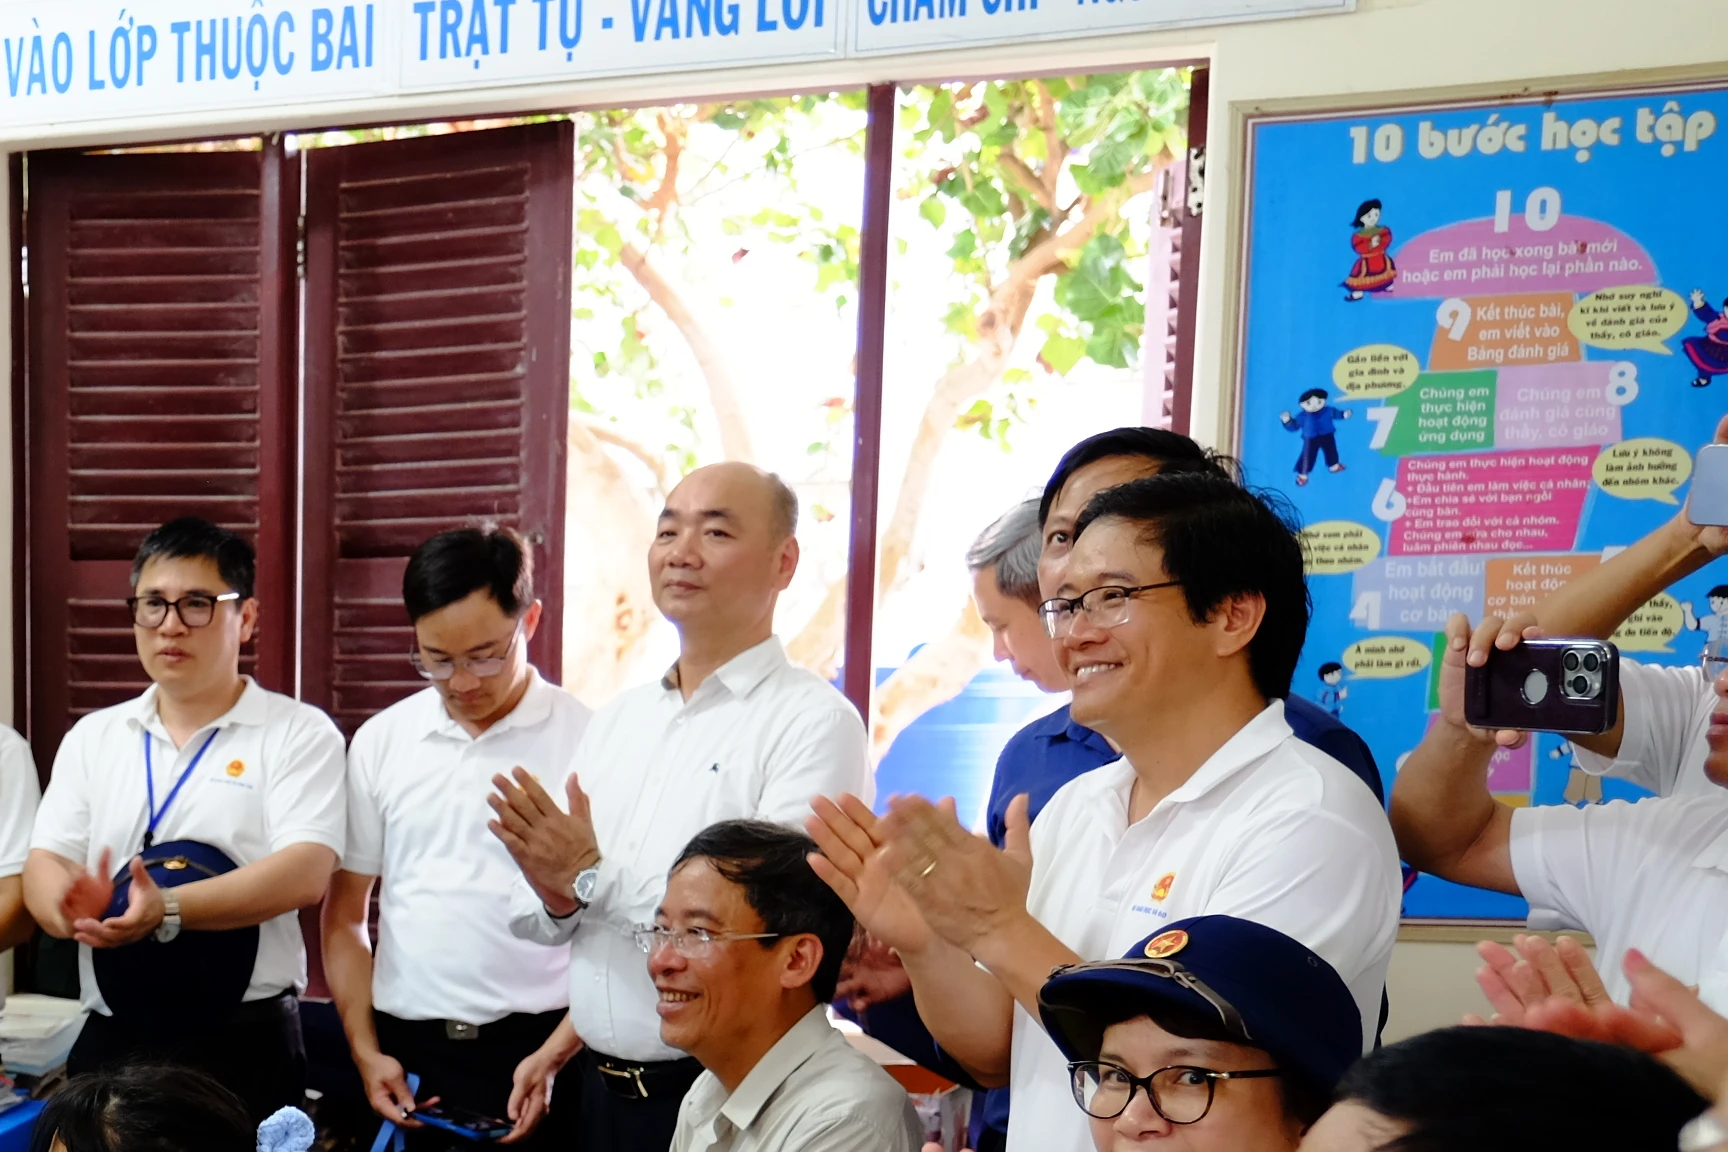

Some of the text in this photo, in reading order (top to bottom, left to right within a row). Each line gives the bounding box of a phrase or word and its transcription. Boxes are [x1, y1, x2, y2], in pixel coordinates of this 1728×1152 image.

[4, 17, 73, 97] VÀO
[89, 8, 158, 90] LỚP
[171, 0, 296, 91] THUỘC
[1349, 100, 1717, 164] 10 bước học tập
[1494, 186, 1562, 233] 10
[1429, 249, 1453, 263] Em
[1458, 246, 1477, 261] đã
[1482, 245, 1510, 263] học
[1514, 243, 1553, 259] xong
[1402, 253, 1642, 285] hoặc em phải học lại phần nào.
[1436, 298, 1472, 341] 9
[1476, 303, 1500, 321] Kết
[1504, 303, 1535, 320] thúc
[1479, 322, 1560, 341] em viết vào
[1467, 342, 1569, 363] Bảng đánh giá
[1605, 360, 1640, 406] 8
[1420, 387, 1489, 400] Chúng em
[1421, 400, 1486, 415] thực hiện
[1366, 406, 1400, 450] 7
[1418, 415, 1487, 429] hoạt động
[1450, 429, 1486, 443] dụng
[1407, 459, 1446, 472] Chúng
[1449, 459, 1467, 469] em
[1528, 455, 1556, 468] hoạt
[1558, 453, 1589, 466] động
[1371, 477, 1407, 523] 6
[1384, 562, 1413, 579] Em
[1513, 561, 1537, 575] Kết
[1349, 591, 1382, 631] 4
